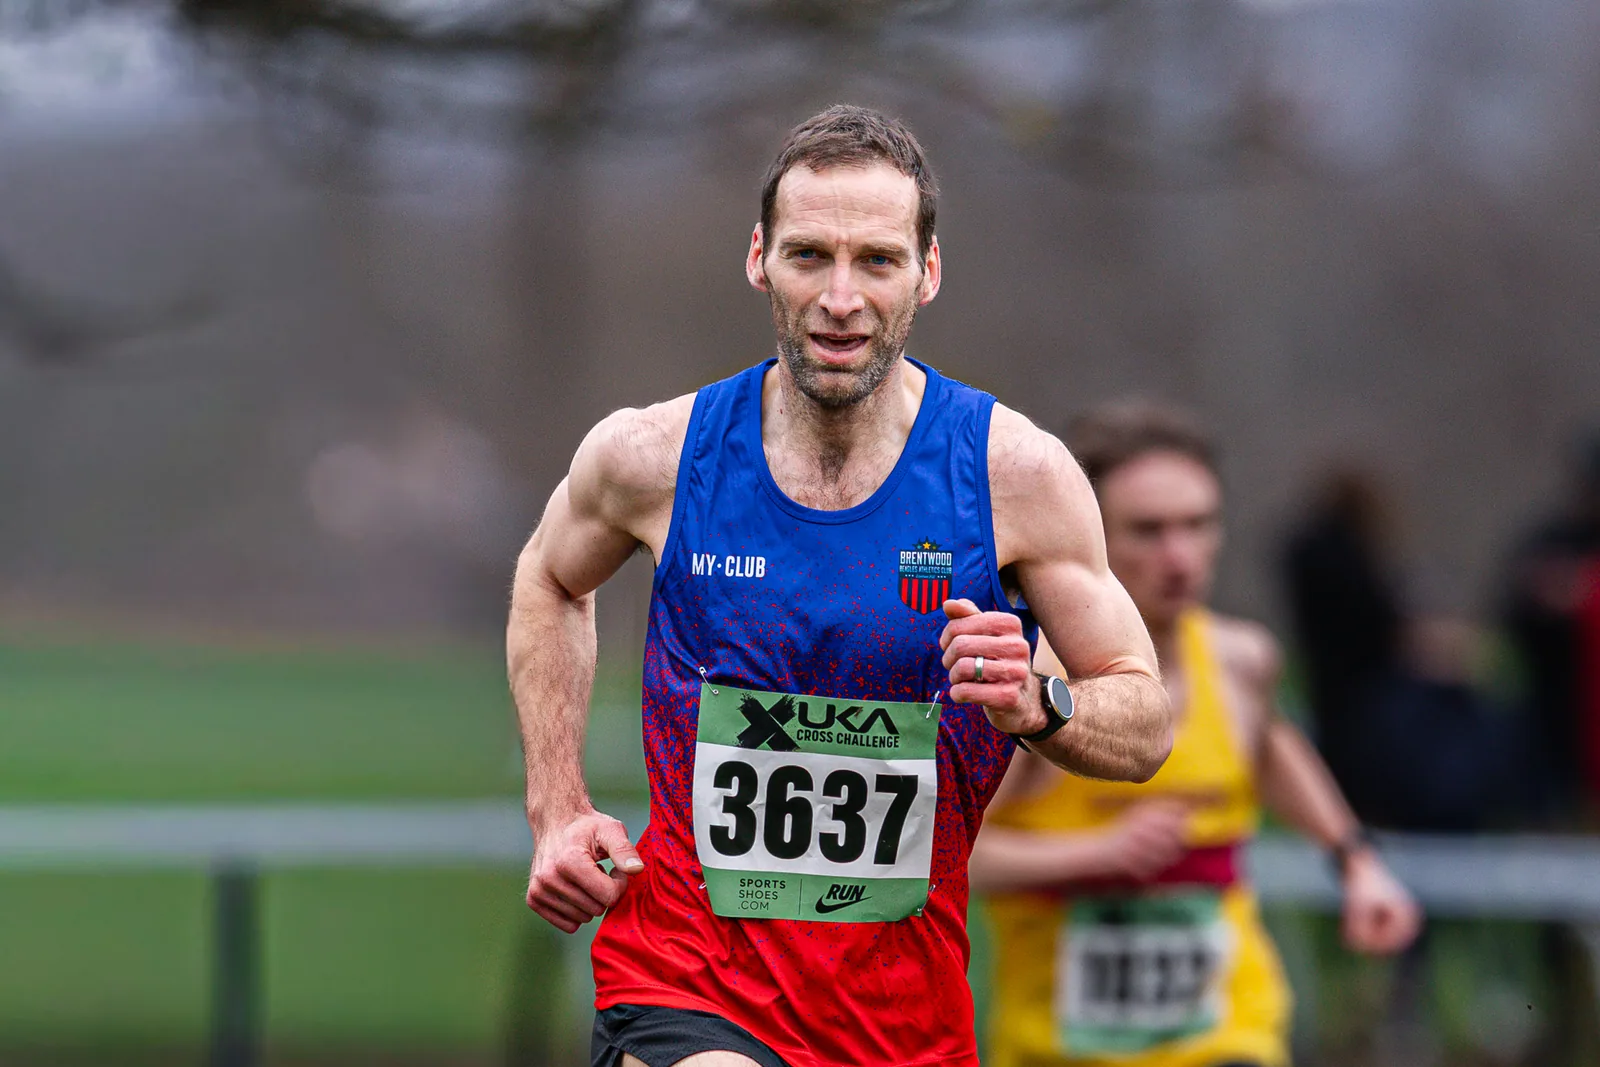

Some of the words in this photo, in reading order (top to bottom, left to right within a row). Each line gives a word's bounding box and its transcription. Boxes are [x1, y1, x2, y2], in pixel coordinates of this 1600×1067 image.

[900, 551, 952, 566] BRENTWOOD
[797, 701, 900, 735] UKA
[796, 729, 833, 743] CROSS
[836, 732, 900, 749] CHALLENGE
[709, 760, 919, 865] 3637
[739, 878, 786, 889] SPORTS
[738, 889, 779, 900] SHOES
[825, 883, 867, 902] RUN
[737, 900, 770, 911] .COM
